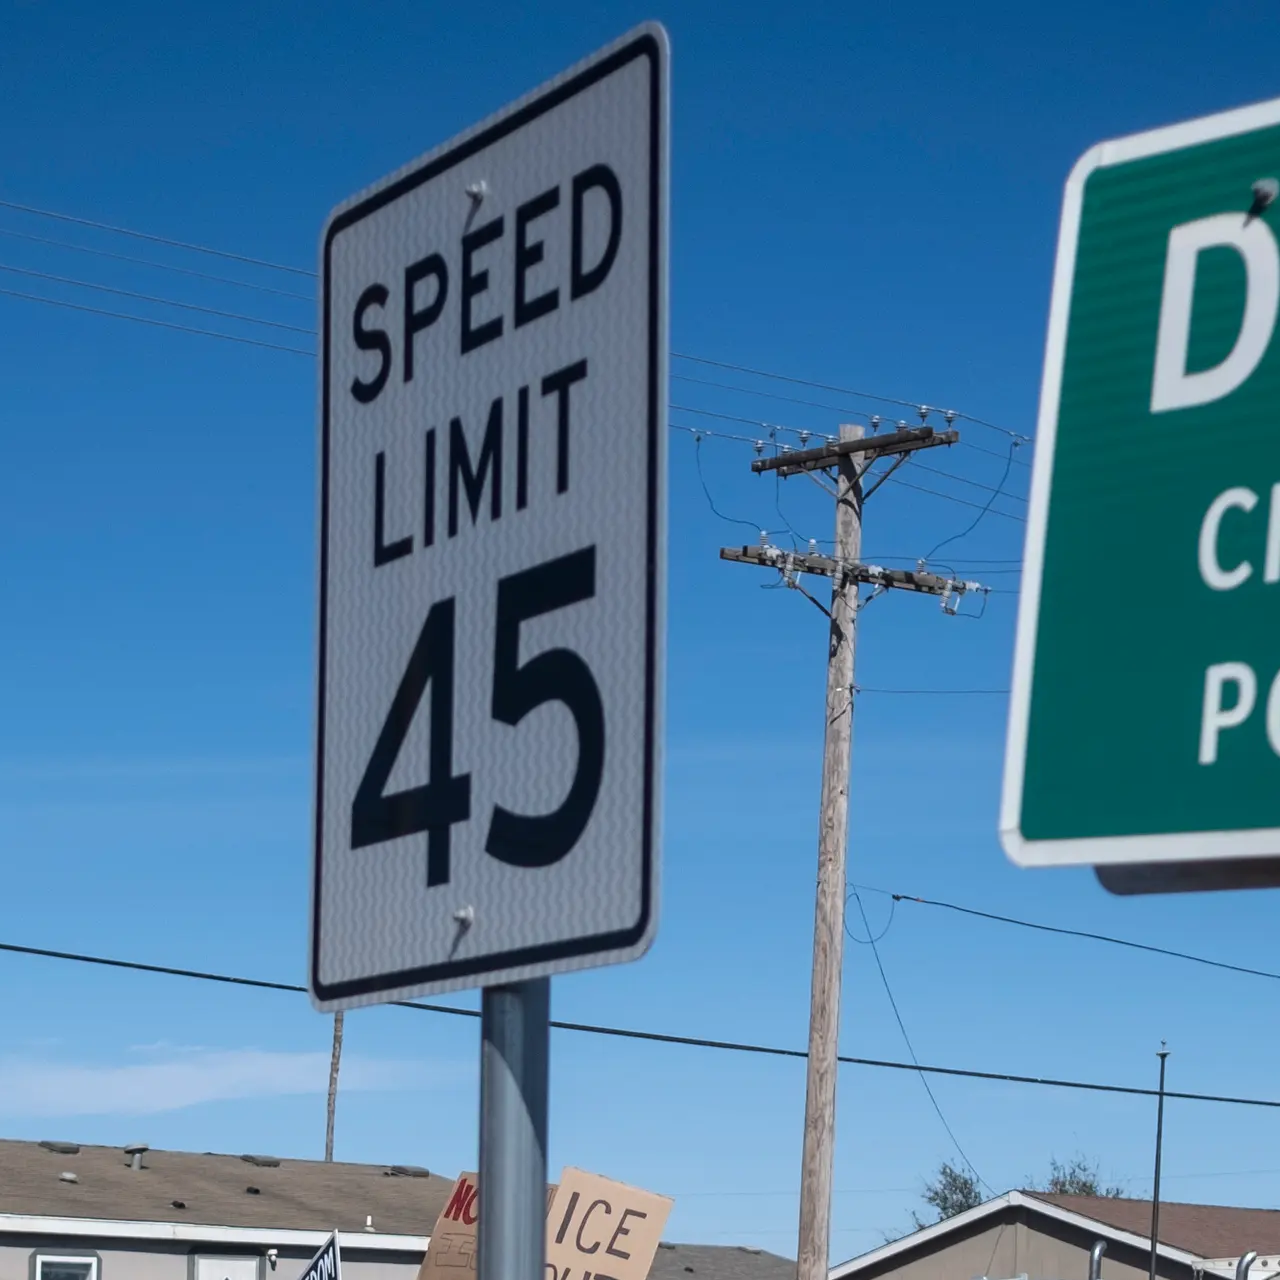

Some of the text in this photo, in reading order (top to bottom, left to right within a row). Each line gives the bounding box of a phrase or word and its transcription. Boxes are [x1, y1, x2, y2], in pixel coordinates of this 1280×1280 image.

[350, 163, 623, 404] SPEED
[374, 358, 588, 568] LIMIT
[351, 543, 606, 888] 45
[554, 1191, 648, 1260] ICE
